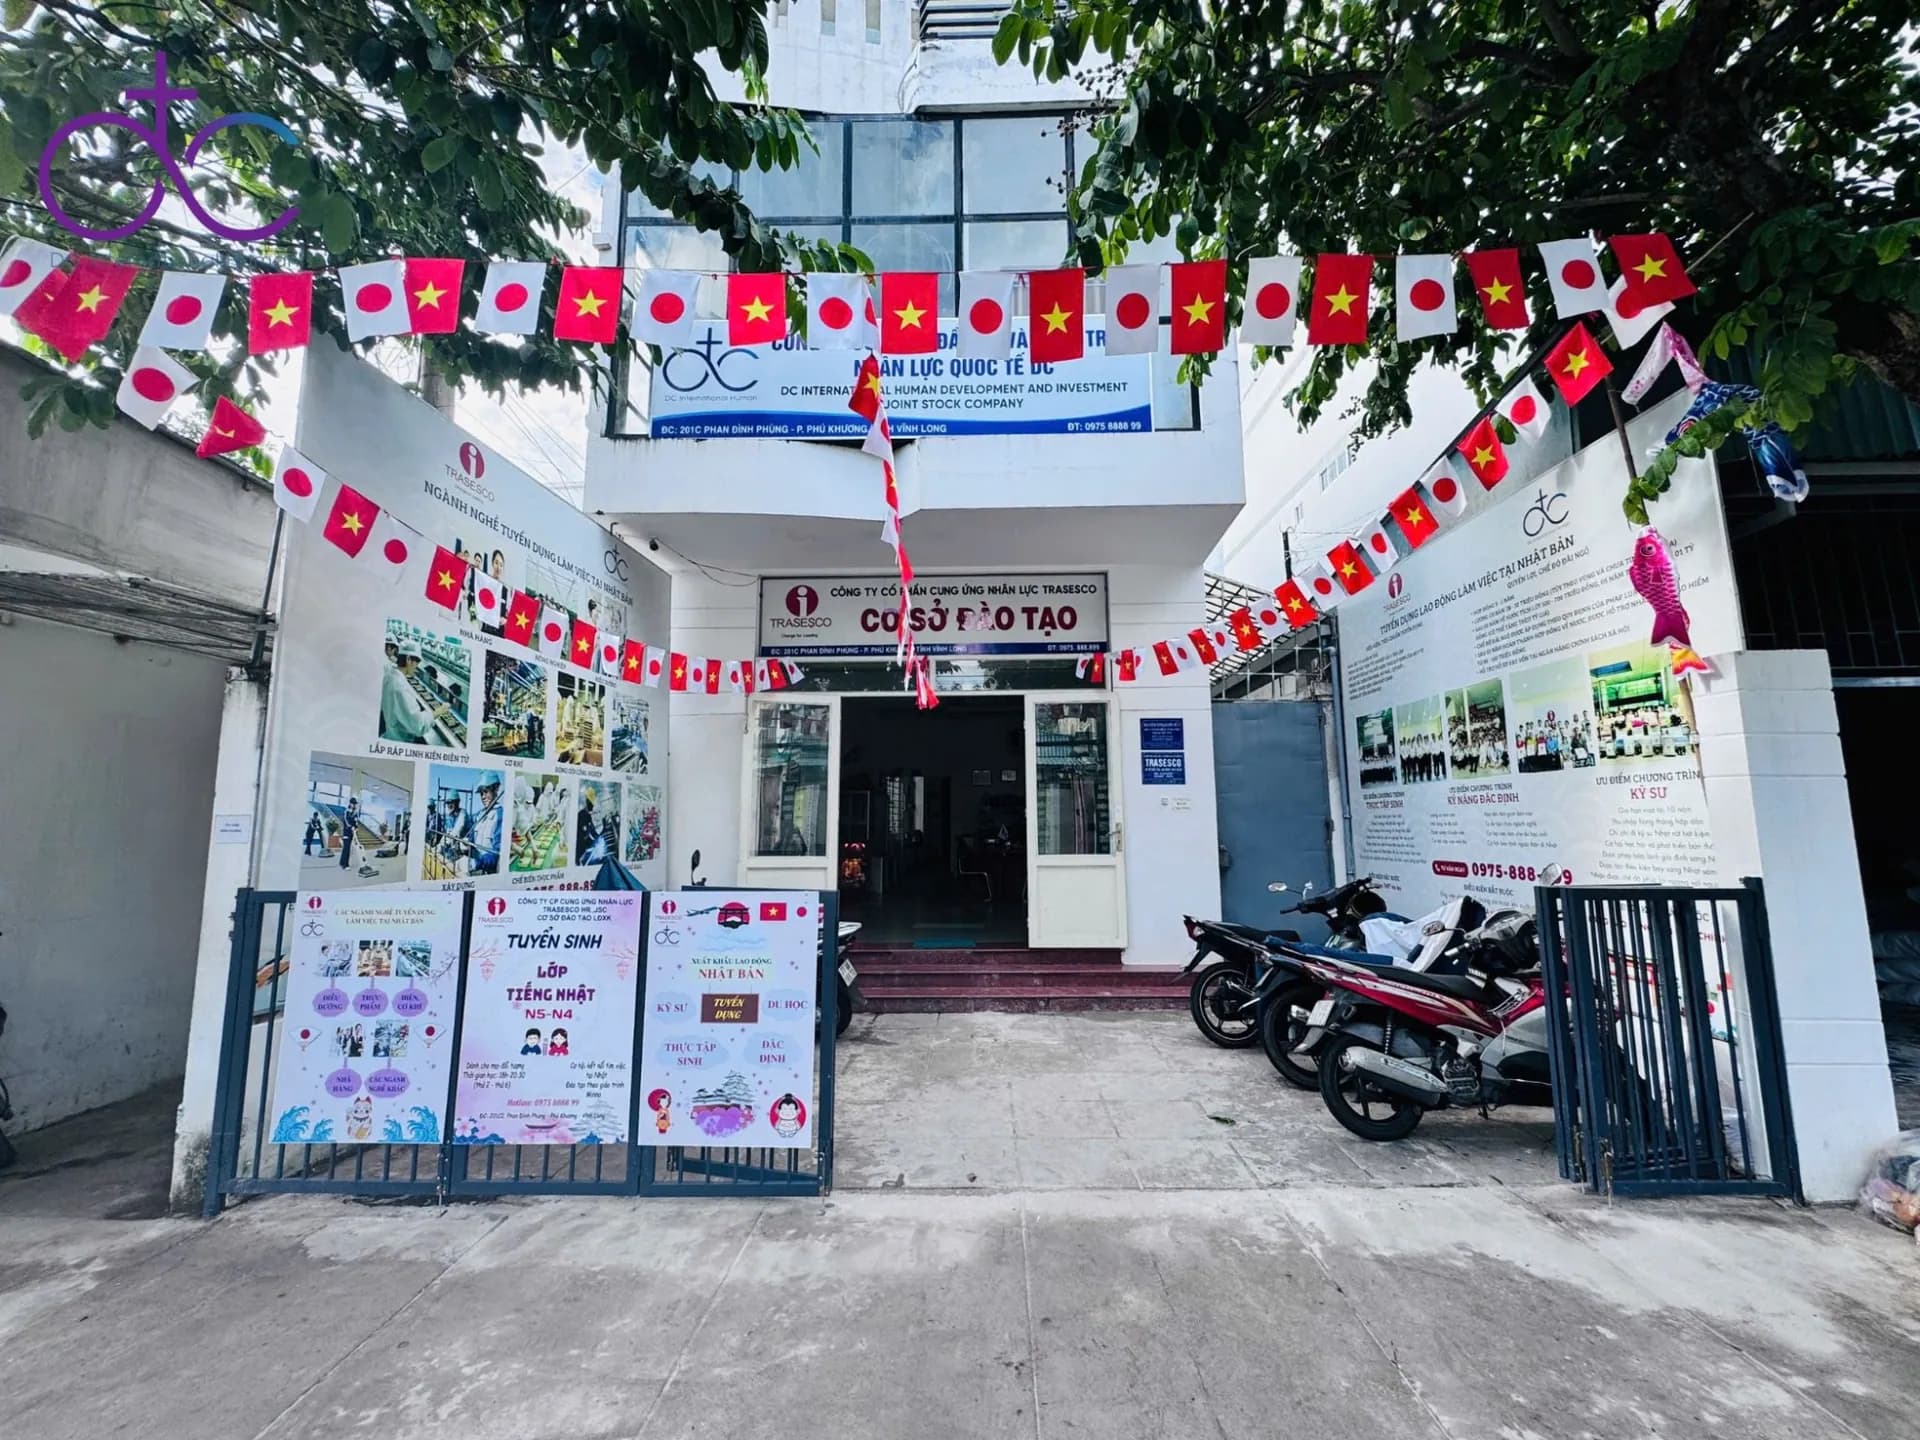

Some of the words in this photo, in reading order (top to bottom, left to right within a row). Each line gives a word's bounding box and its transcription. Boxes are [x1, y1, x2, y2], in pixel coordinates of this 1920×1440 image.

[910, 357, 945, 380] LỰC
[780, 385, 798, 396] DC
[894, 384, 937, 396] HUMAN
[940, 383, 1024, 396] DEVELOPMENT
[1027, 383, 1053, 394] AND
[1056, 381, 1128, 394] INVESTMENT
[883, 398, 918, 410] JOINT
[921, 397, 961, 409] STOCK
[964, 397, 1024, 409] COMPANY
[703, 425, 730, 434] PHAN
[797, 424, 805, 434] P.
[807, 422, 826, 434] PHÚ
[921, 424, 947, 433] LONG
[1085, 421, 1106, 431] 0975
[1108, 421, 1129, 431] 8888
[1131, 421, 1142, 431] 99
[445, 463, 495, 502] TRASESCO
[1457, 581, 1476, 598] LÀM
[1516, 549, 1548, 570] NHẬT
[1549, 534, 1575, 556] BẢN
[830, 586, 861, 598] CÔNG
[865, 587, 878, 597] TY
[929, 585, 959, 596] CUNG
[988, 583, 1016, 595] NHÂN
[1018, 584, 1039, 597] LỰC
[1043, 583, 1097, 595] TRASESCO
[769, 617, 832, 629] TRASESCO
[1021, 605, 1078, 637] TẠO
[1145, 758, 1182, 768] TRASESCO
[507, 926, 561, 949] TUYỂN
[563, 934, 603, 949] SINH
[537, 961, 568, 979] LỚP
[698, 966, 735, 982] NHẬT
[738, 965, 764, 979] BẢN
[506, 981, 552, 1002] TIẾNG
[555, 984, 596, 1005] NHẬT
[784, 1000, 809, 1011] HỌC
[524, 1008, 573, 1020] N5-N4
[714, 1010, 743, 1021] DỤNG
[677, 1057, 703, 1066] SINH
